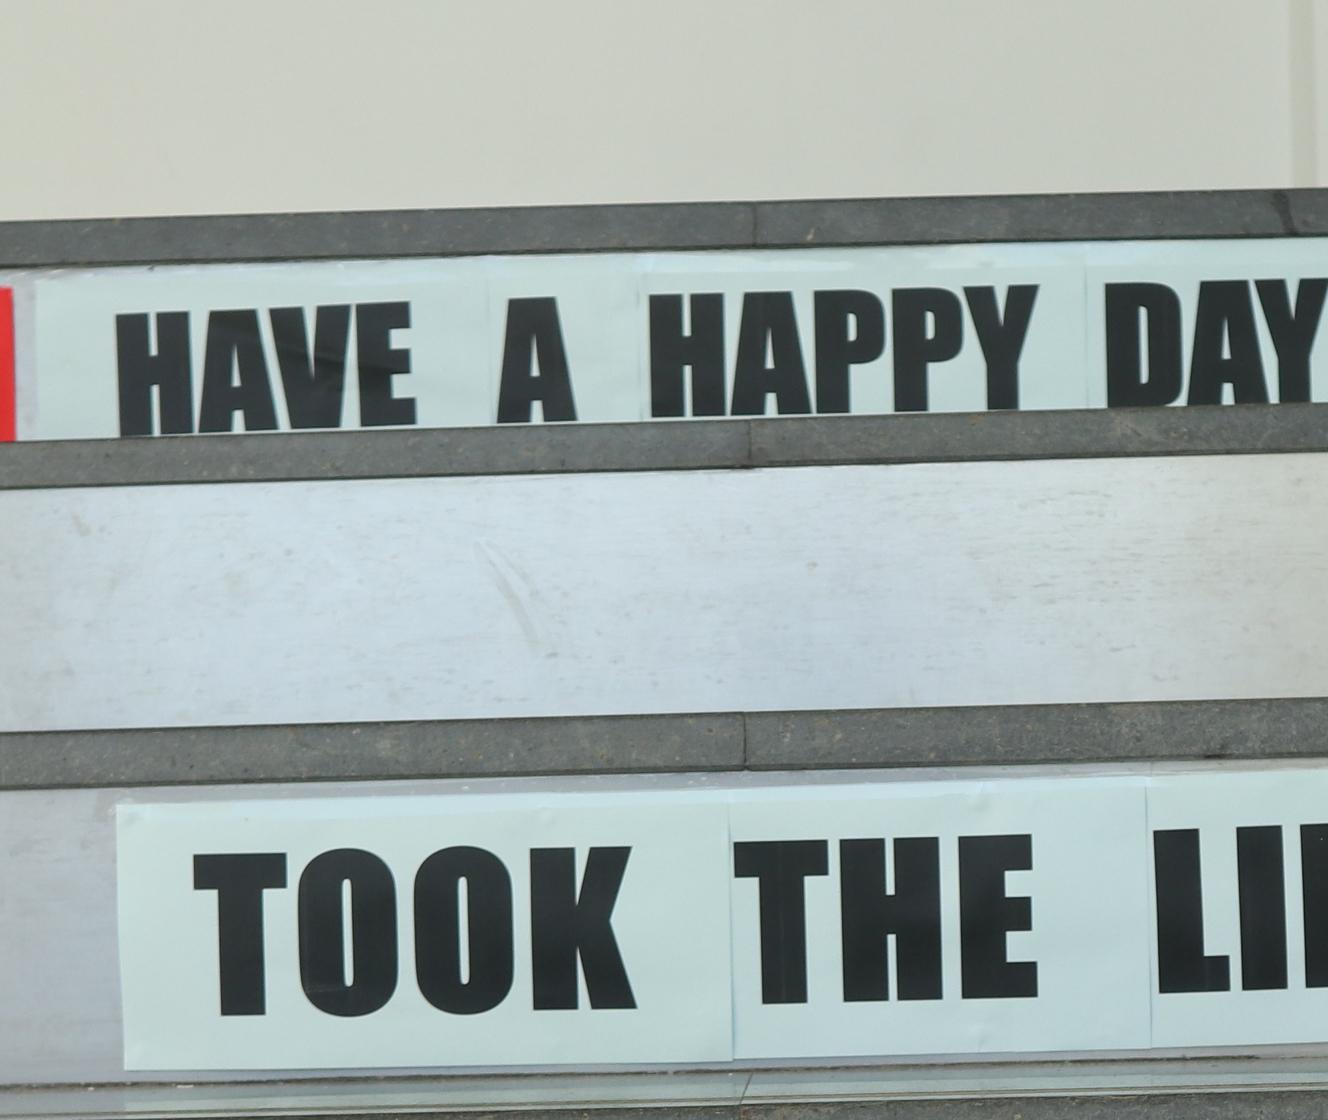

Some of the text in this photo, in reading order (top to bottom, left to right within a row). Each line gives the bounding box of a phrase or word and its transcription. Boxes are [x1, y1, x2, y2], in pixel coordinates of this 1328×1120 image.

[115, 300, 418, 436] HAVE
[496, 297, 577, 423] A
[649, 284, 1038, 417] HAPPY
[193, 844, 638, 1018] TOOK
[734, 833, 1038, 1005] THE
